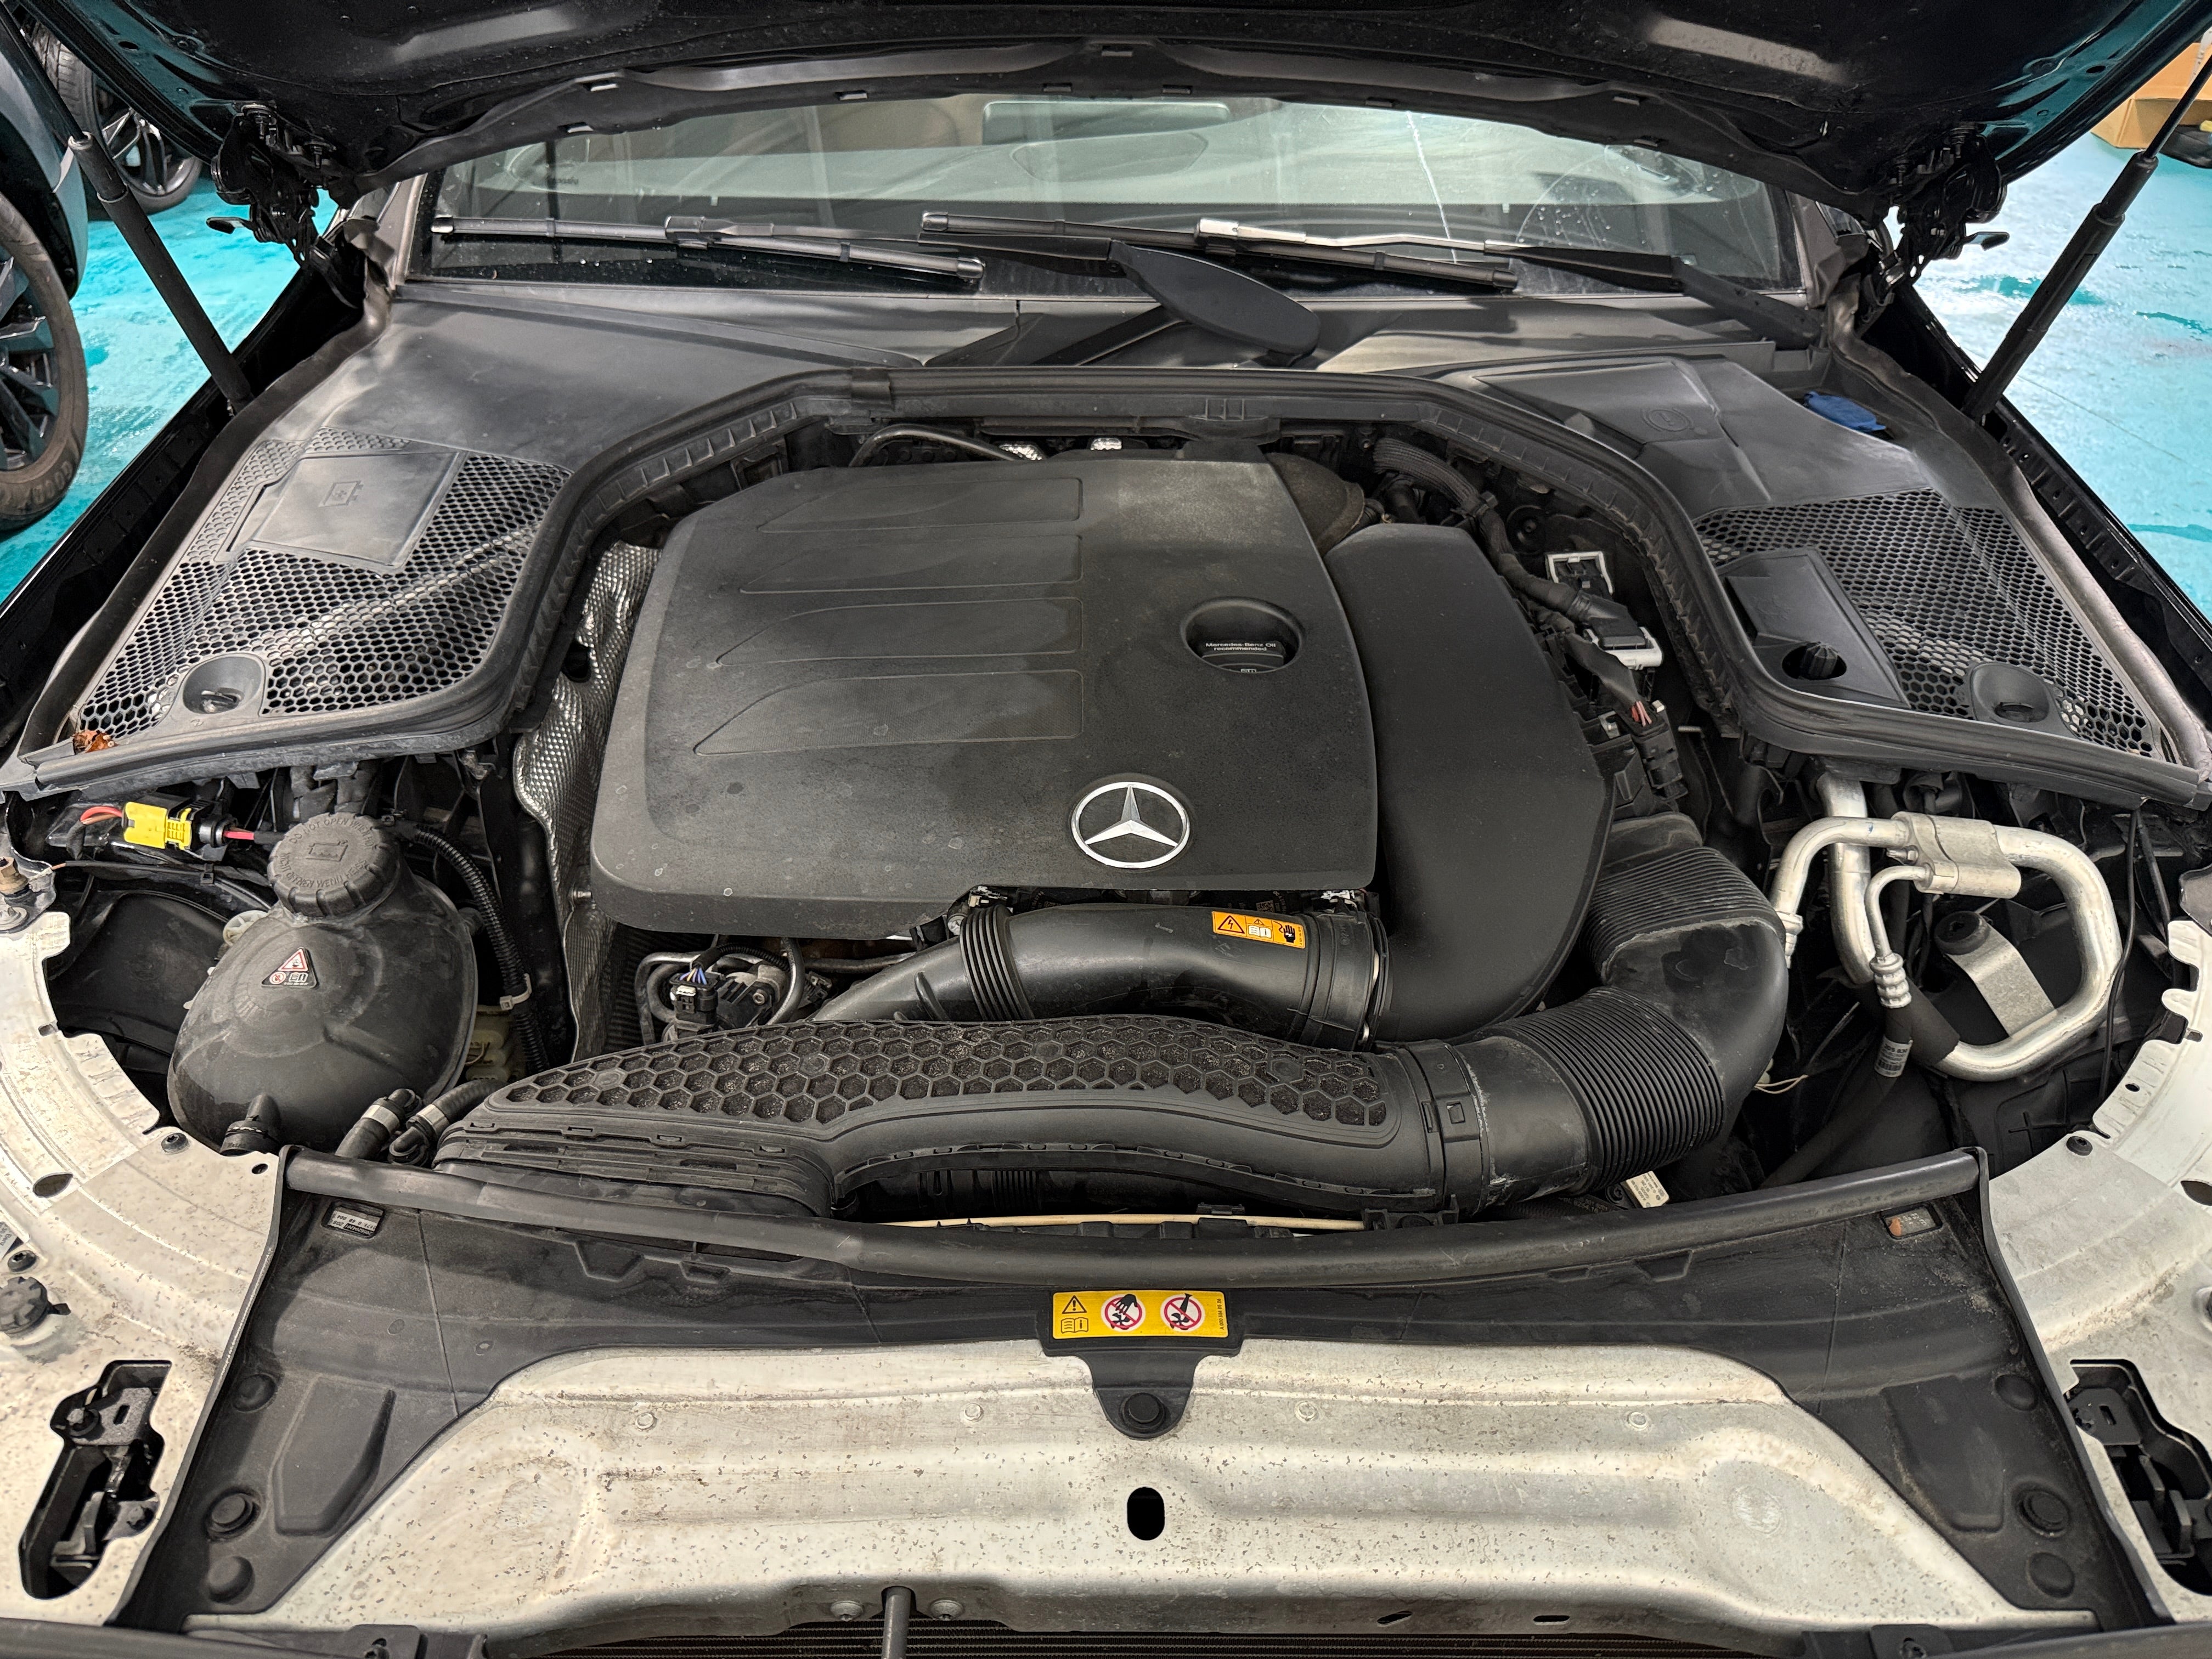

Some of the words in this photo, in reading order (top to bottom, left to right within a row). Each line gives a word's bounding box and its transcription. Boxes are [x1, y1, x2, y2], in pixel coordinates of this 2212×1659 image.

[289, 833, 303, 844] DO
[303, 821, 320, 836] NOT
[350, 820, 371, 837] WHEN
[280, 852, 291, 873] NICHT
[317, 874, 343, 888] WENN
